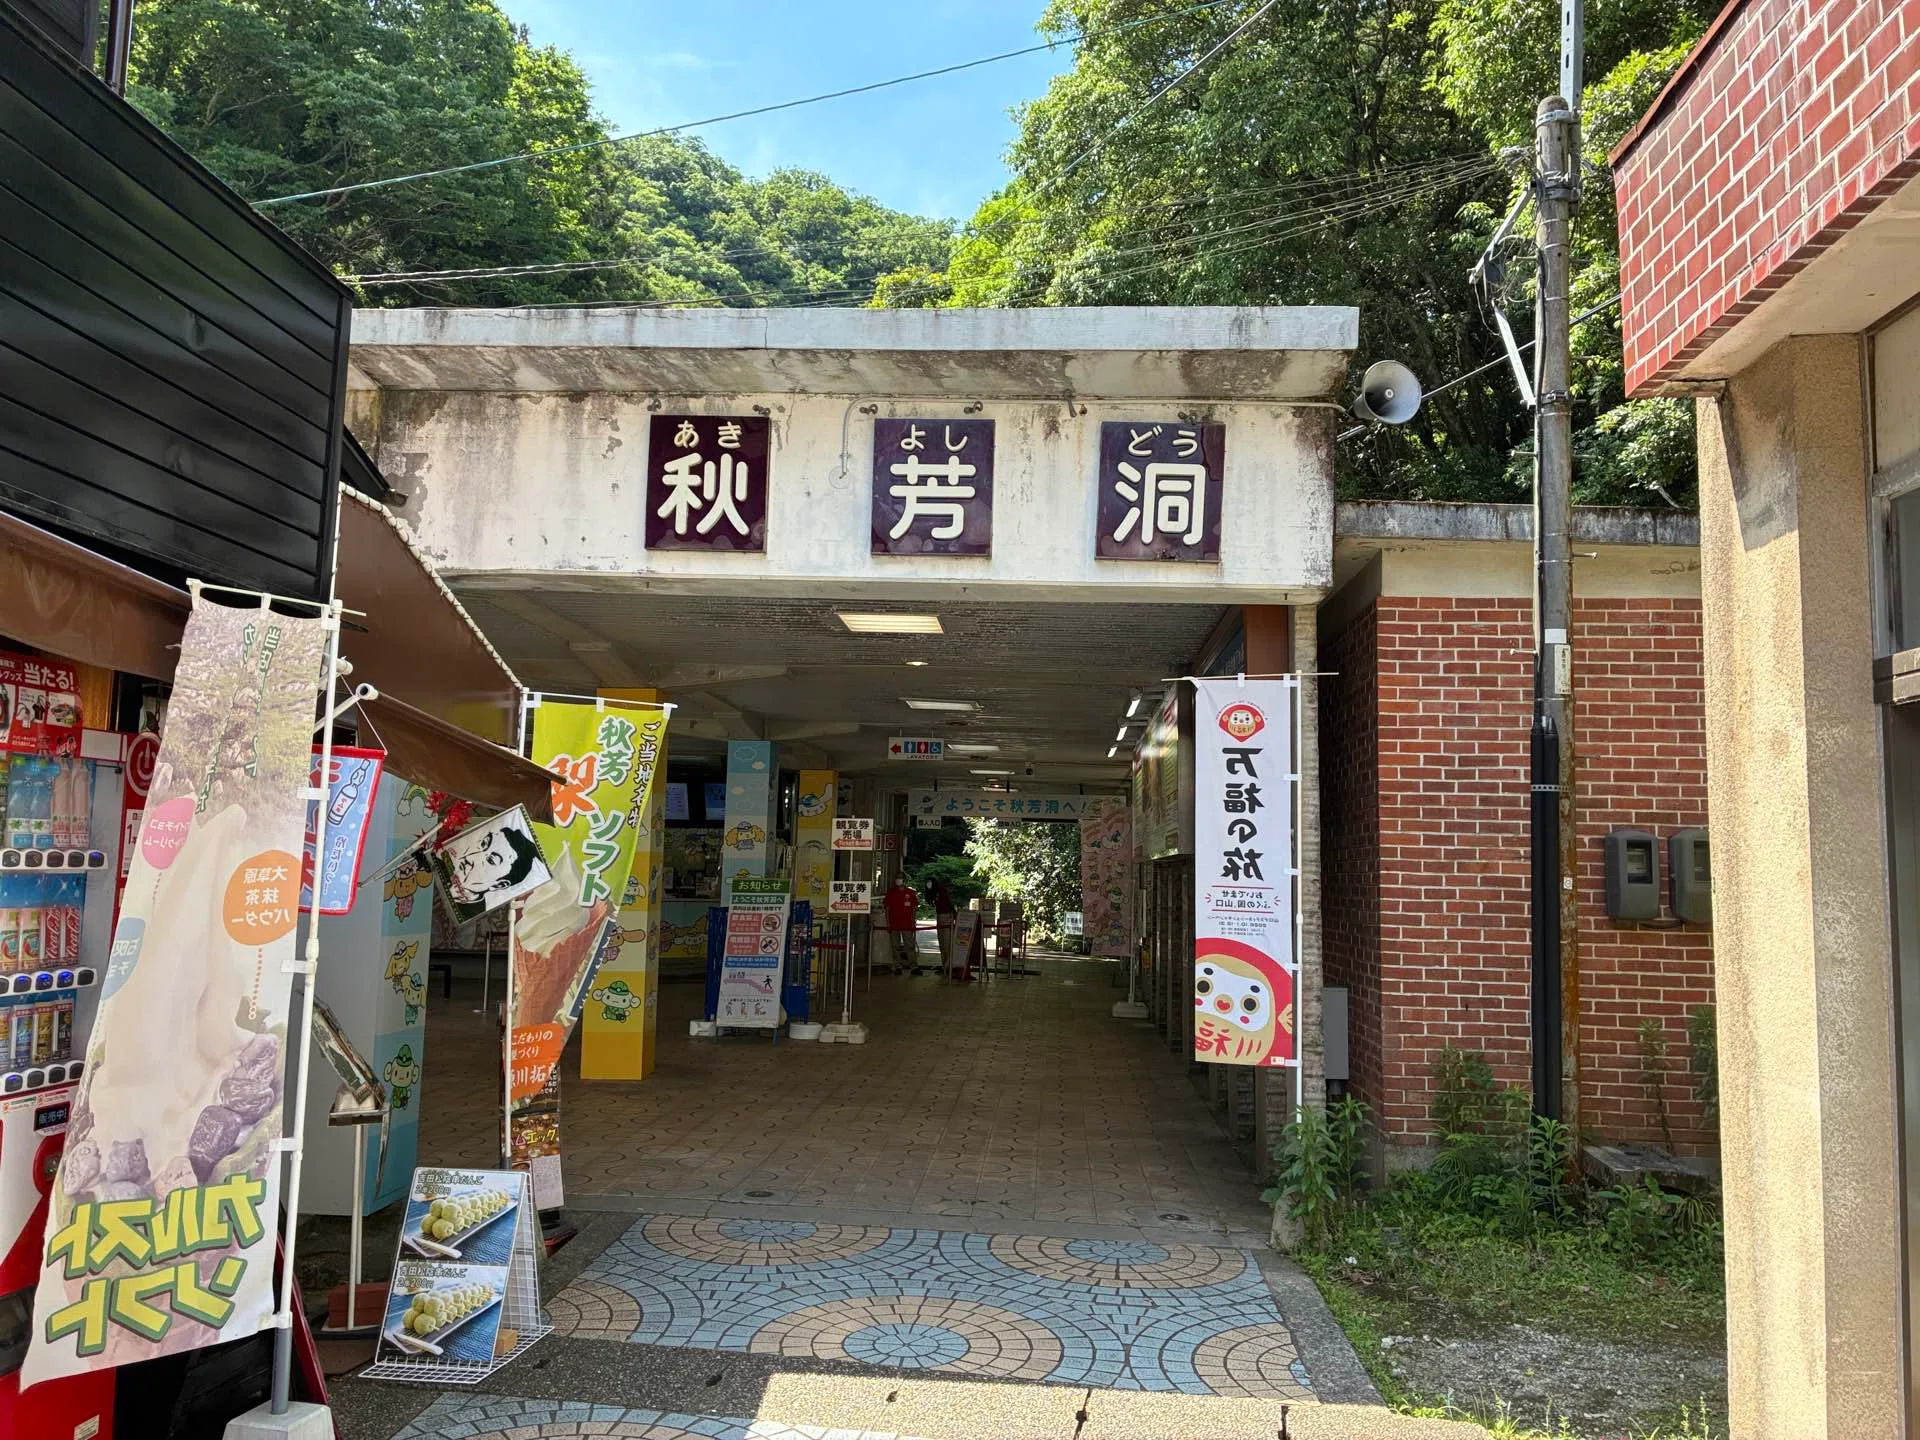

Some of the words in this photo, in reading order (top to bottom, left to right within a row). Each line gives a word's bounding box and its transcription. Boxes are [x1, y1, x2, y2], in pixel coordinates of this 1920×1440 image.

[673, 420, 743, 449] あき
[900, 424, 968, 451] よし
[1127, 425, 1199, 457] どう
[657, 452, 750, 536] 秋
[888, 455, 976, 540] 芳
[1112, 461, 1206, 545] 洞
[598, 716, 635, 785] 秋芳
[836, 820, 870, 830] 観覧券
[842, 830, 862, 839] 売場
[580, 811, 624, 905] ソフト
[738, 881, 784, 890] お知らせ
[833, 883, 867, 893] 観覧券
[839, 893, 859, 902] 売場
